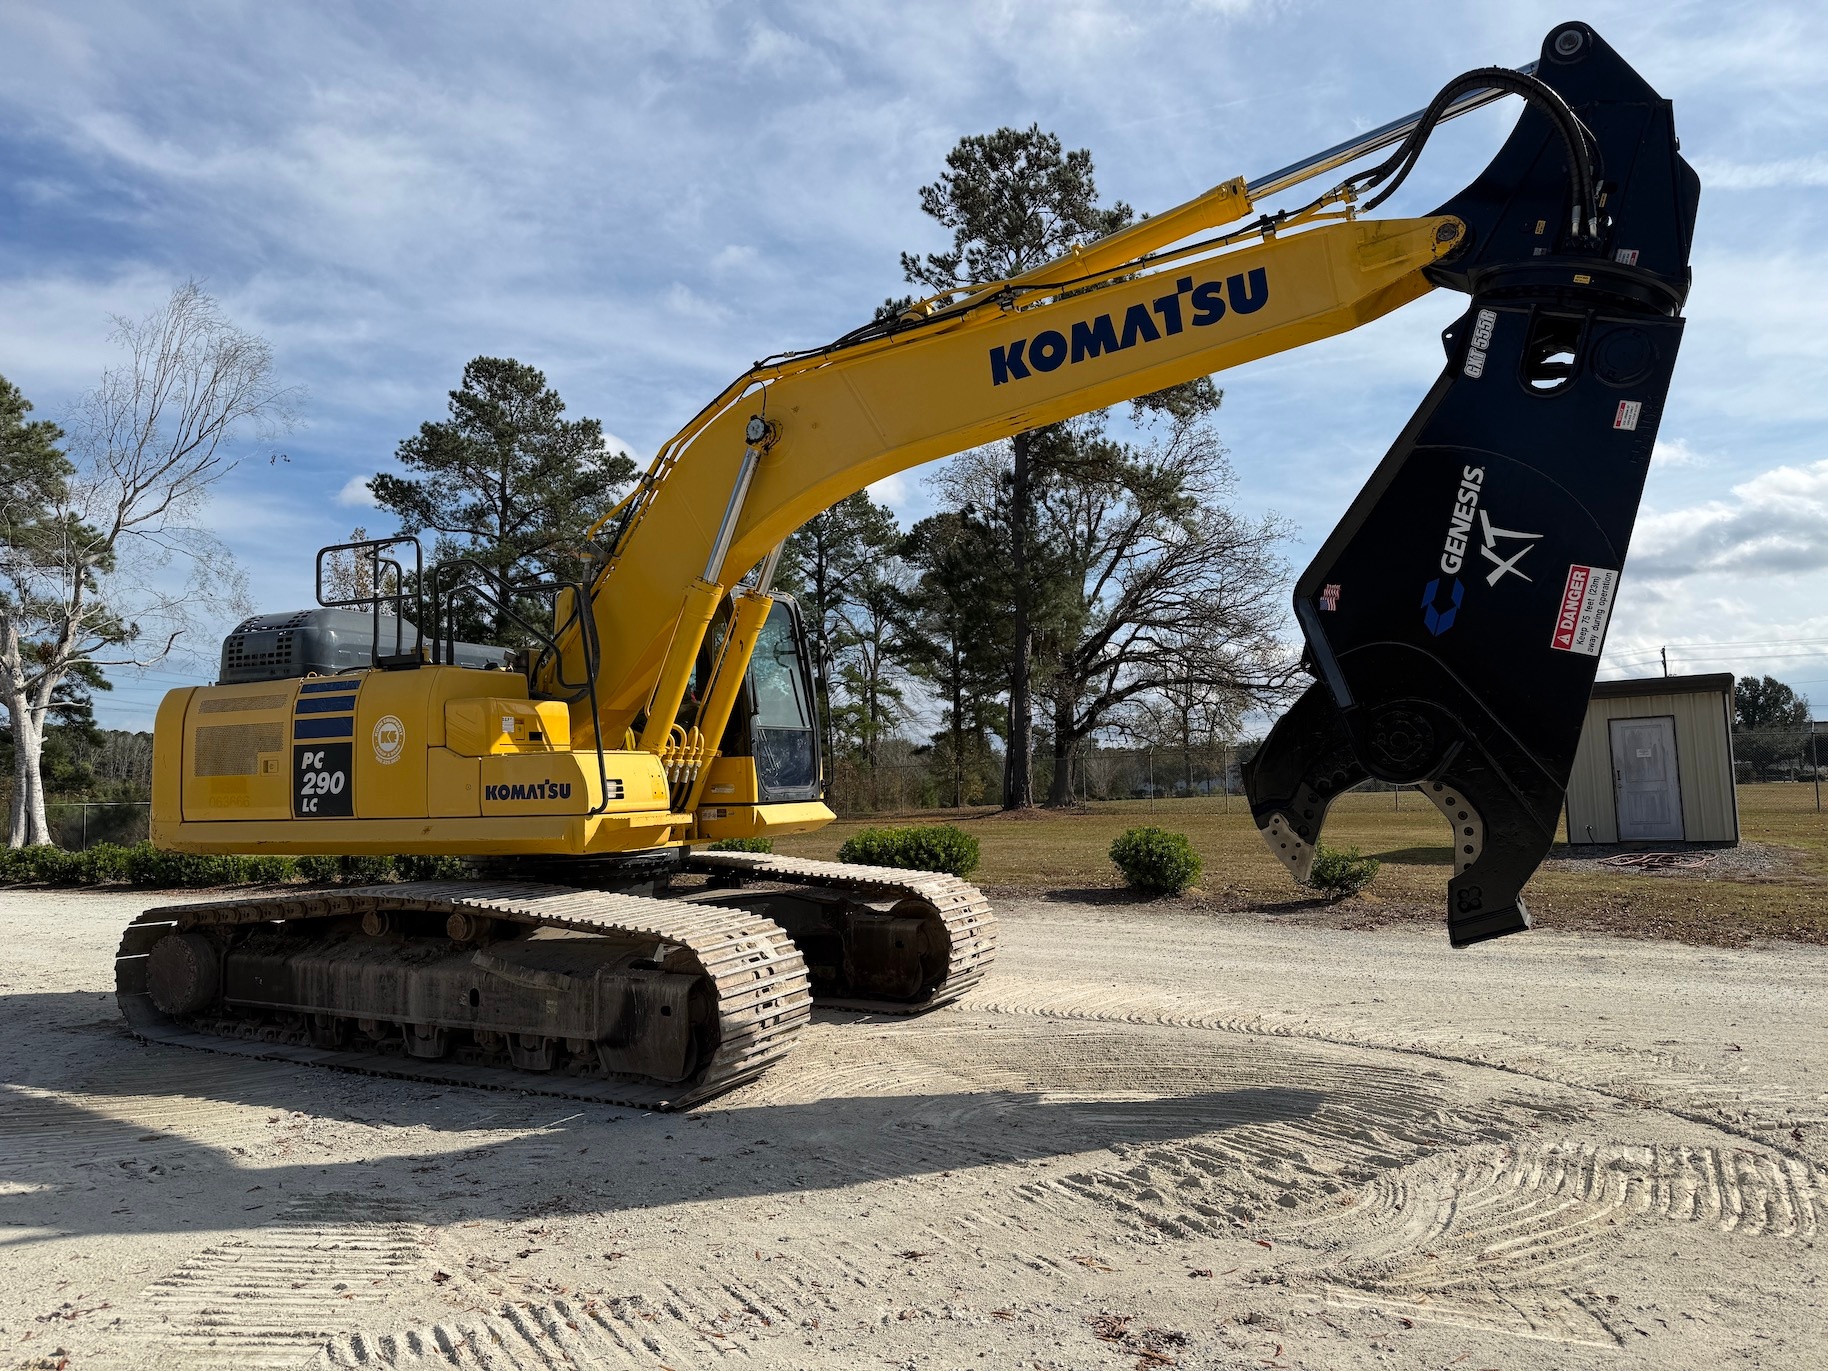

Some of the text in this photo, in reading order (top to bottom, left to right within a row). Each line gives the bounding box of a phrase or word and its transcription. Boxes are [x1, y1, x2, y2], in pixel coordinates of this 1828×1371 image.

[989, 267, 1269, 386] KOMATSU
[1464, 309, 1497, 378] GXT 555R
[1441, 465, 1484, 574] GENESIS
[1560, 570, 1587, 631] DANGER
[1576, 576, 1601, 645] Keep 75 feet (23m)
[1587, 572, 1612, 653] away during operation
[301, 751, 325, 769] PC
[301, 771, 345, 795] 290
[485, 779, 571, 800] KOMATSU
[302, 798, 318, 812] LC
